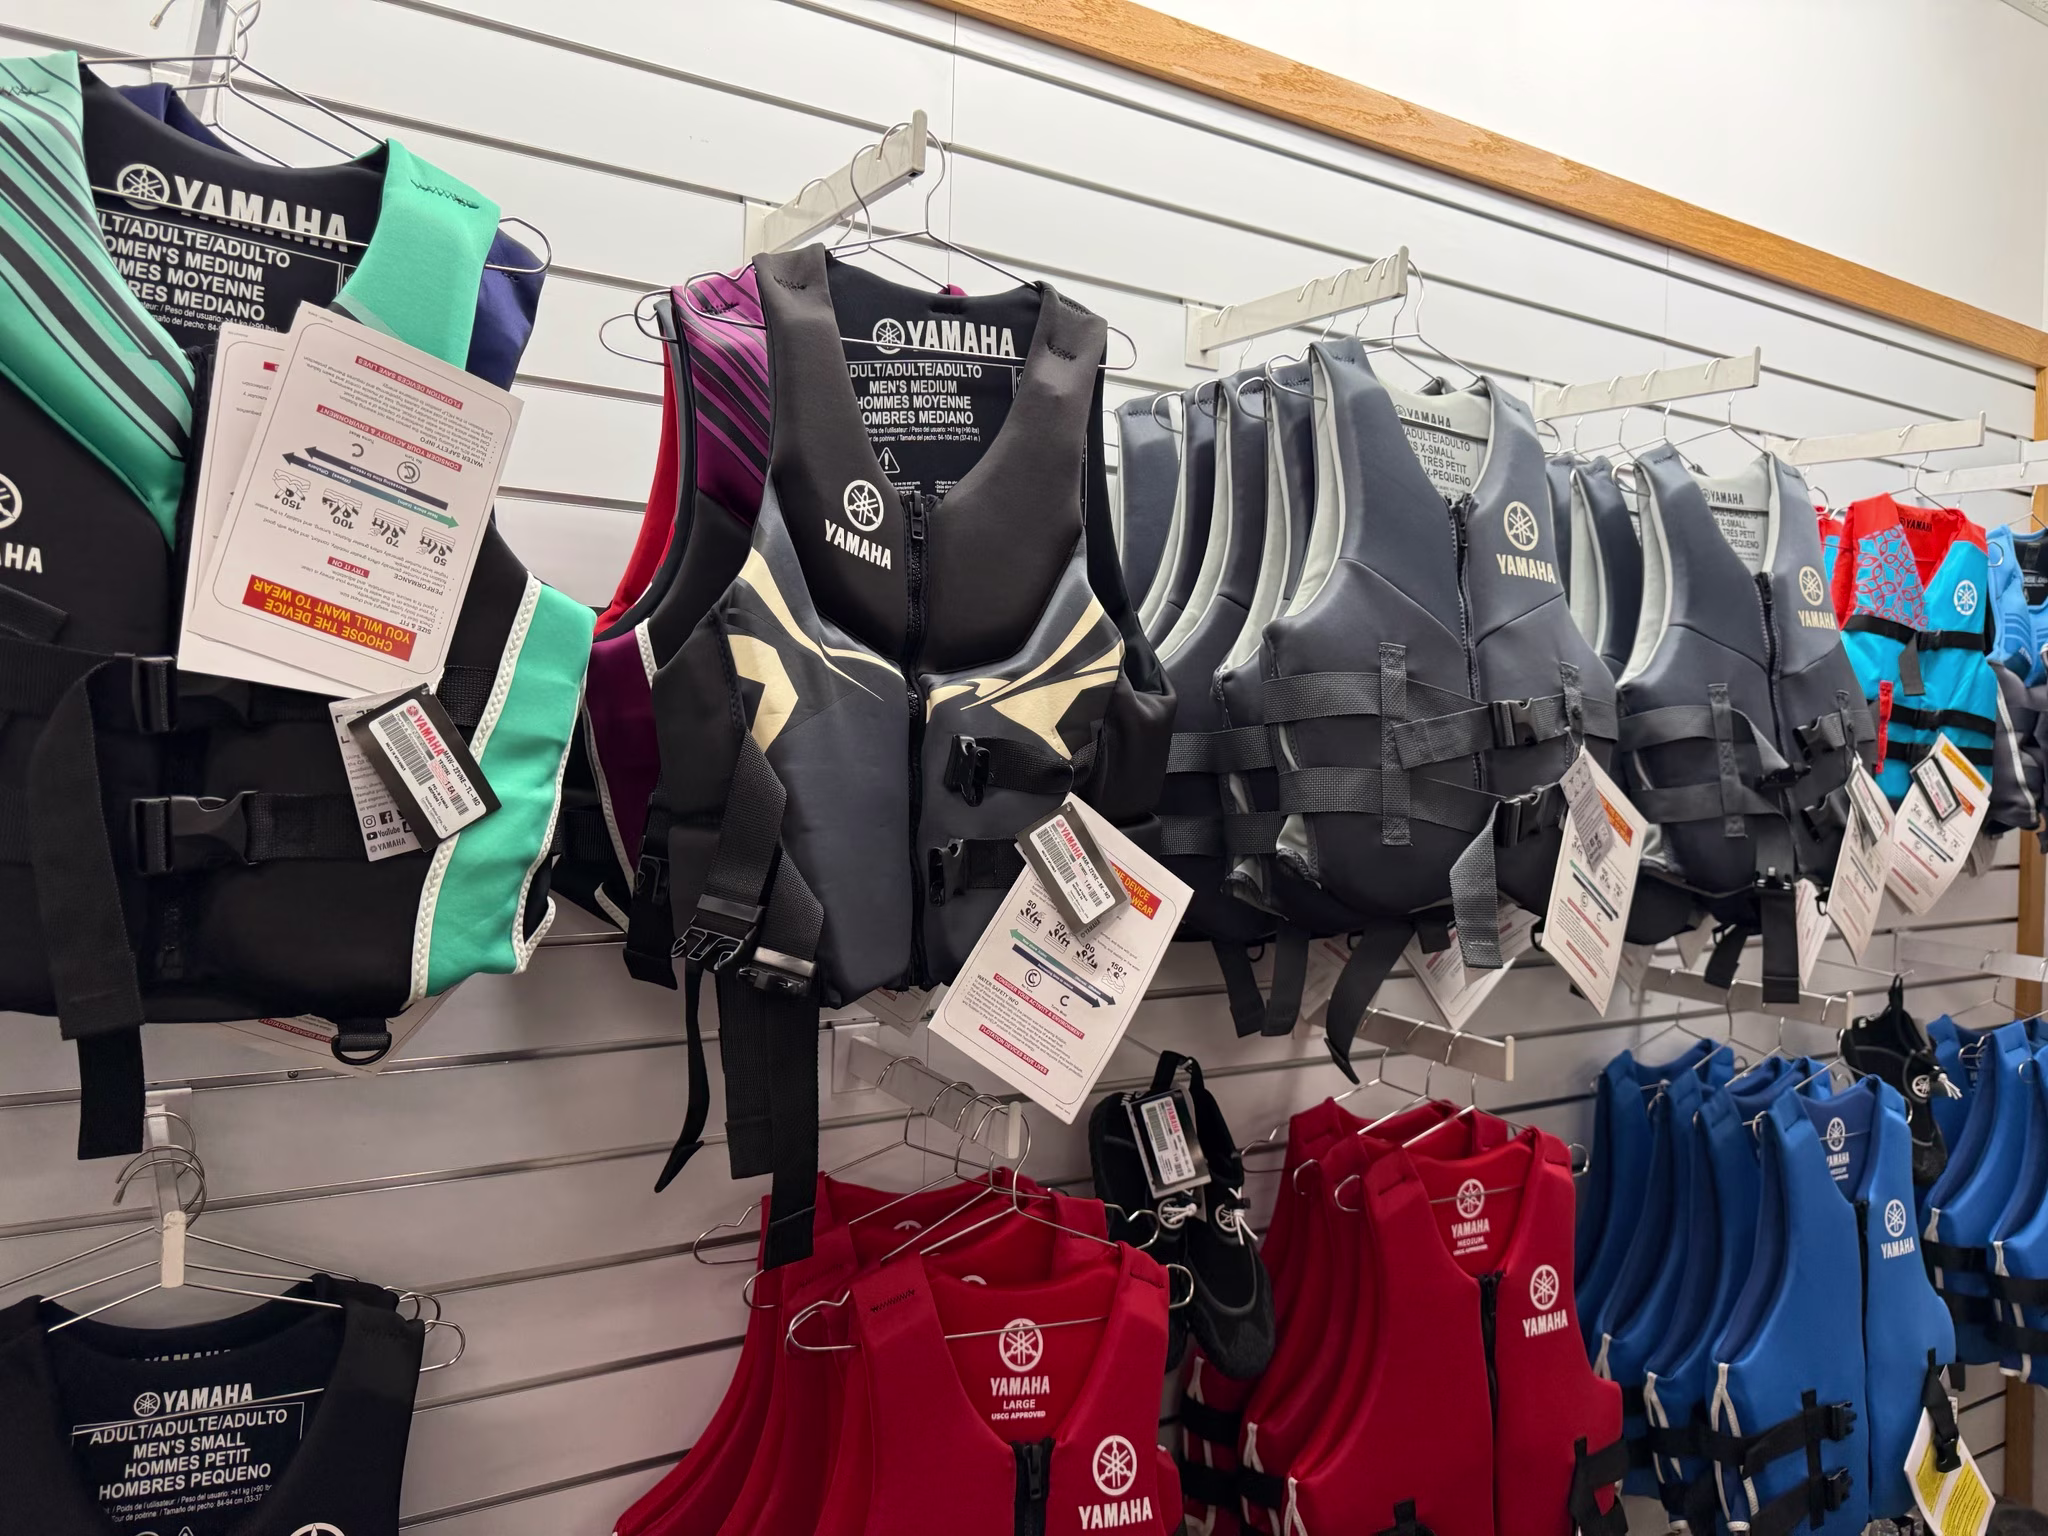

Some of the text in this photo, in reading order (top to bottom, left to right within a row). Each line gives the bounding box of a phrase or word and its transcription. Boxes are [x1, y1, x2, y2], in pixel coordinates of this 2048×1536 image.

[174, 175, 347, 252] YAMAHA
[100, 214, 291, 269] LT/ADULTE/ADULTO
[106, 235, 264, 282] OMEN'S MEDIUM
[166, 268, 266, 302] MOYENNE
[165, 305, 223, 322] Peso del usuario:
[173, 288, 265, 322] MEDIANO
[171, 316, 206, 330] del pecho:
[906, 320, 1015, 357] YAMAHA
[357, 357, 461, 407] FLOTATION DEVICES SAVE LIVES
[850, 364, 981, 378] DULT/ADULTE/ADULTO
[869, 379, 957, 395] MEN'S MEDIUM
[856, 394, 971, 410] HOMMES MOYENNE
[319, 406, 369, 431] ENVIRONMENT
[862, 409, 973, 426] OMBRES MEDIANO
[1407, 408, 1450, 427] YAMAHA
[376, 430, 406, 447] ACTIVITY
[406, 443, 426, 455] YOUR
[419, 436, 483, 467] WATER SAFETY INFO
[425, 451, 459, 470] CONSIDER
[1420, 443, 1454, 459] X-SMALL
[1446, 461, 1466, 473] PETIT
[1710, 490, 1743, 504] YAMAHA
[281, 496, 446, 565] 50 70 100 150
[825, 518, 890, 569] YAMAHA
[331, 558, 342, 567] ON
[349, 565, 365, 576] TRY
[1496, 553, 1555, 583] YAMAHA
[393, 572, 443, 595] PERFORMANCE
[253, 578, 409, 643] YOU WILL WANT TO WEAR
[1798, 610, 1836, 629] YAMAHA
[263, 598, 391, 652] CHOOSE THE DEVICE
[416, 624, 431, 634] SIZE
[413, 714, 446, 757] YAMAHA
[446, 785, 456, 794] EA
[377, 825, 400, 837] YouTube
[1060, 826, 1084, 859] YAMAHA
[377, 837, 406, 850] YAMAHA
[1123, 877, 1150, 901] DEVICE
[1132, 895, 1152, 916] WEAR
[1025, 899, 1123, 973] 50 70 150
[976, 973, 1019, 1006] WATER SAFETY INFO
[994, 974, 1017, 993] CONSIDER
[1016, 989, 1030, 1001] YOUR
[1028, 997, 1047, 1013] ACTIVITY
[1051, 1014, 1082, 1037] ENVIRONMENT
[980, 1025, 1047, 1074] FLOTATION DEVICES SAVE LIVES
[1451, 1217, 1490, 1238] YAMAHA
[1880, 1236, 1915, 1259] YAMAHA
[1522, 1309, 1568, 1337] YAMAHA
[163, 1384, 254, 1410] YAMAHA
[990, 1375, 1049, 1396] YAMAHA
[1003, 1398, 1035, 1409] LARGE
[1010, 1410, 1045, 1419] APPROVED
[90, 1408, 287, 1445] ADULT/ADULTE/ADULTO
[133, 1431, 245, 1459] MEN'S SMALL
[125, 1448, 249, 1479] HOMMES PETIT
[99, 1463, 271, 1501] HOMBRES PEQUENO
[116, 1503, 133, 1512] Poids
[180, 1495, 195, 1503] Peso
[206, 1490, 229, 1499] usuario:
[242, 1487, 249, 1495] kg
[163, 1505, 185, 1514] Tamaño
[186, 1503, 195, 1511] del
[196, 1501, 215, 1511] pecho:
[1077, 1496, 1152, 1529] YAMAHA
